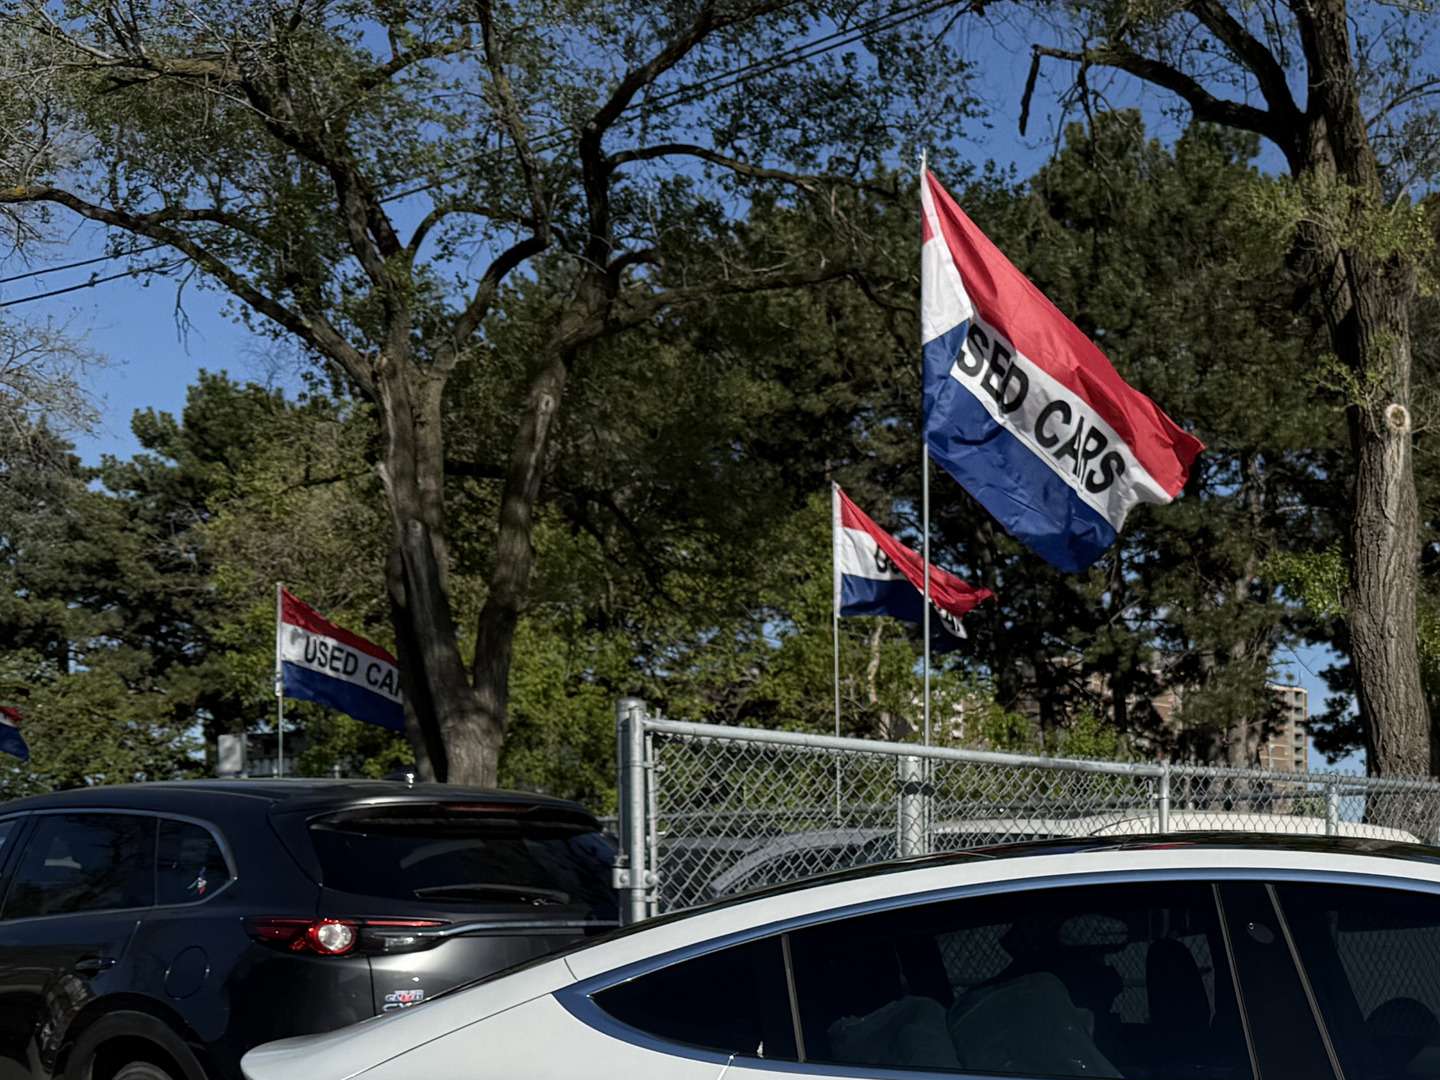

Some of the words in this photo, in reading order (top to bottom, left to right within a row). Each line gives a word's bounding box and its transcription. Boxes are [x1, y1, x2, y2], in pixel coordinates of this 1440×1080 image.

[957, 324, 1029, 415] SED
[1034, 399, 1126, 494] CARS
[304, 635, 358, 676] USED
